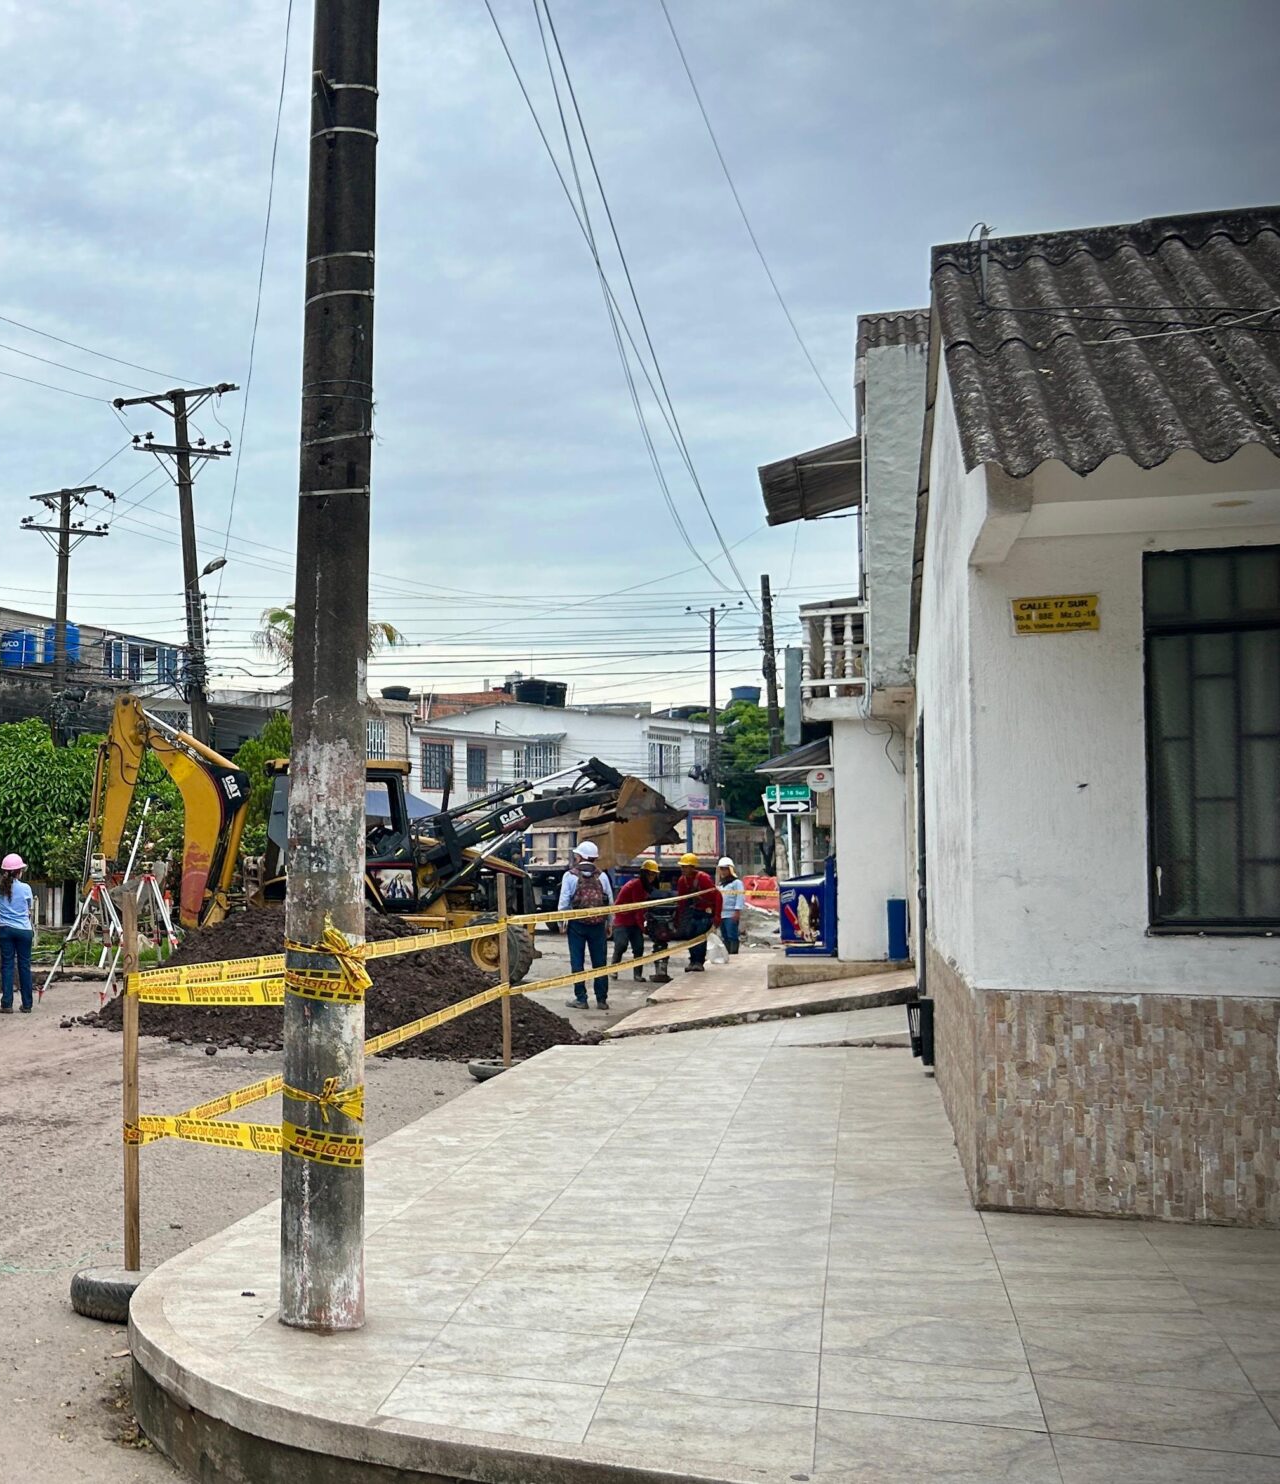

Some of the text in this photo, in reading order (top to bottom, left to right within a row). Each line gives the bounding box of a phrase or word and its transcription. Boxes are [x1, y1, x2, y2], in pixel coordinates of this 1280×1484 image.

[1020, 602, 1052, 611] CALLE
[1067, 600, 1088, 608] SUR
[224, 775, 241, 797] CAT
[500, 806, 524, 824] CAT
[295, 1136, 357, 1158] PELIGRO
